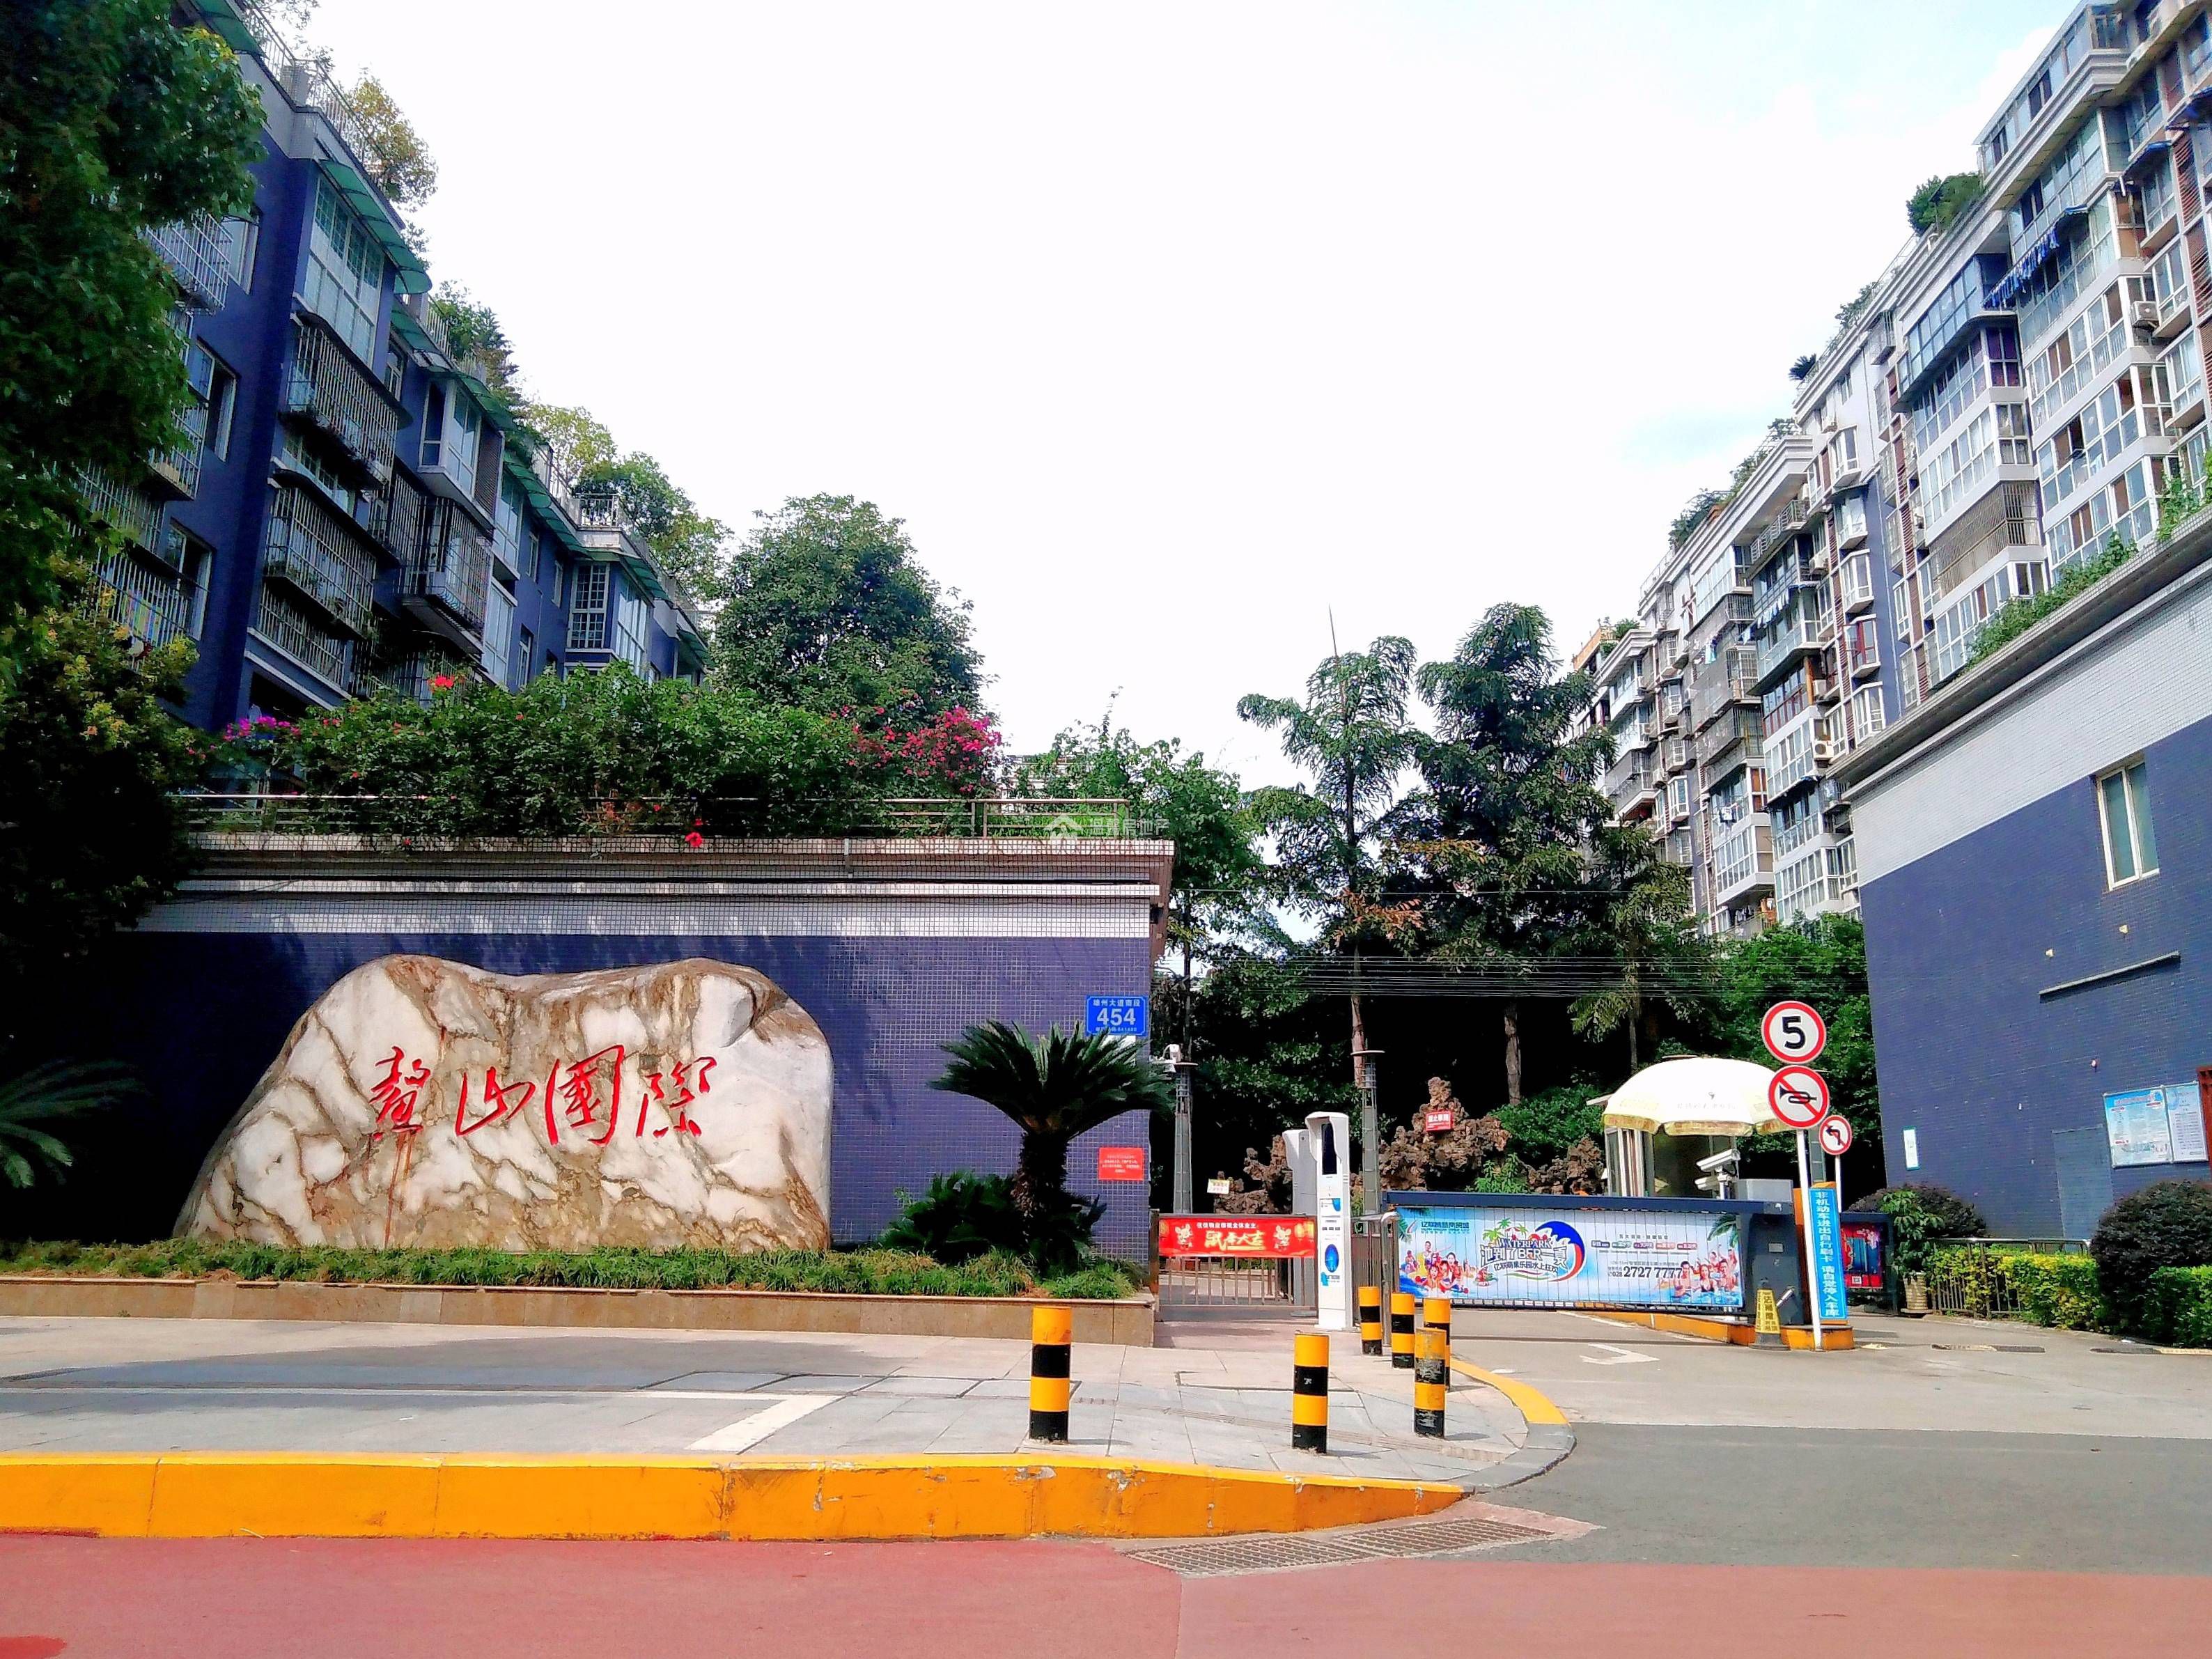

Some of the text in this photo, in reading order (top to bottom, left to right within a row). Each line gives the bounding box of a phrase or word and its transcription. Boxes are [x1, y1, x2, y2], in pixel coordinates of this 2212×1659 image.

[1096, 1007, 1136, 1026] 454
[1782, 1015, 1806, 1050] 5
[1623, 1265, 1651, 1278] 2727
[1653, 1267, 1683, 1279] 7777
